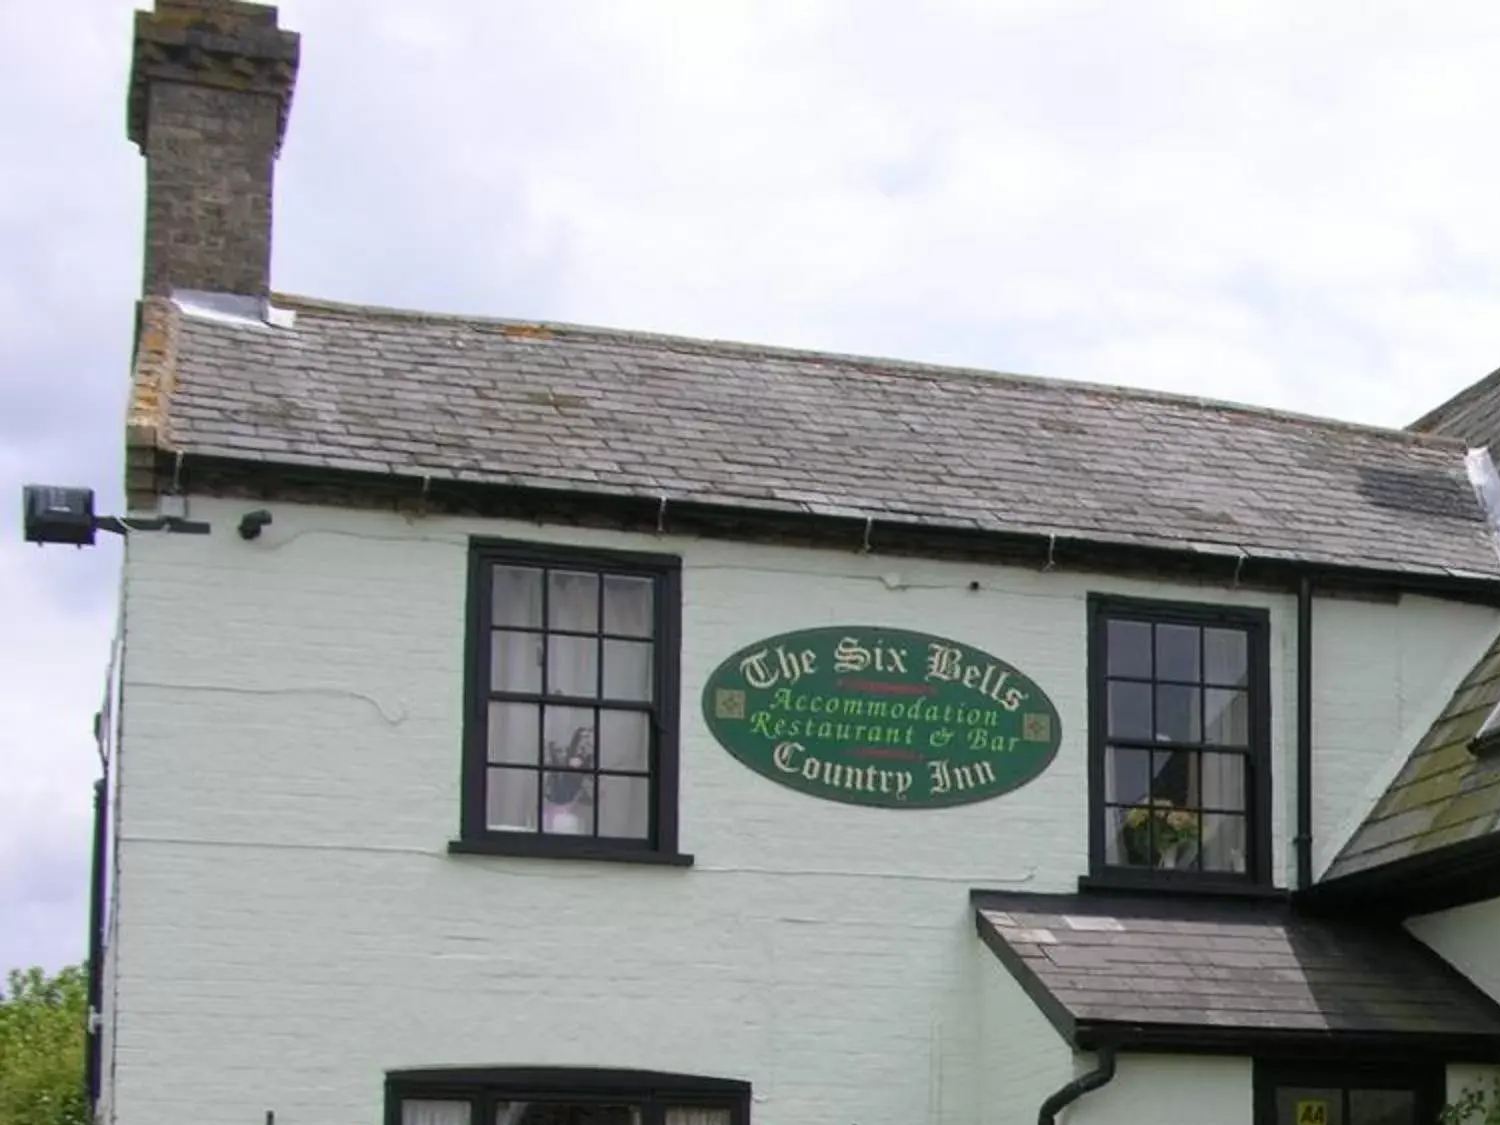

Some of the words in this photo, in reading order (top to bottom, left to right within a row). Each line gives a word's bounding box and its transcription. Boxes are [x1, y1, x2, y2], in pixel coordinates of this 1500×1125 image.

[740, 645, 818, 688] The
[833, 637, 908, 673] Six
[924, 643, 1030, 712] Bells
[751, 711, 914, 745] Restaurant
[929, 727, 954, 747] &
[967, 728, 1020, 752] Bar
[769, 687, 998, 727] Accommodation
[773, 741, 913, 800] Country
[928, 759, 997, 794] Inn
